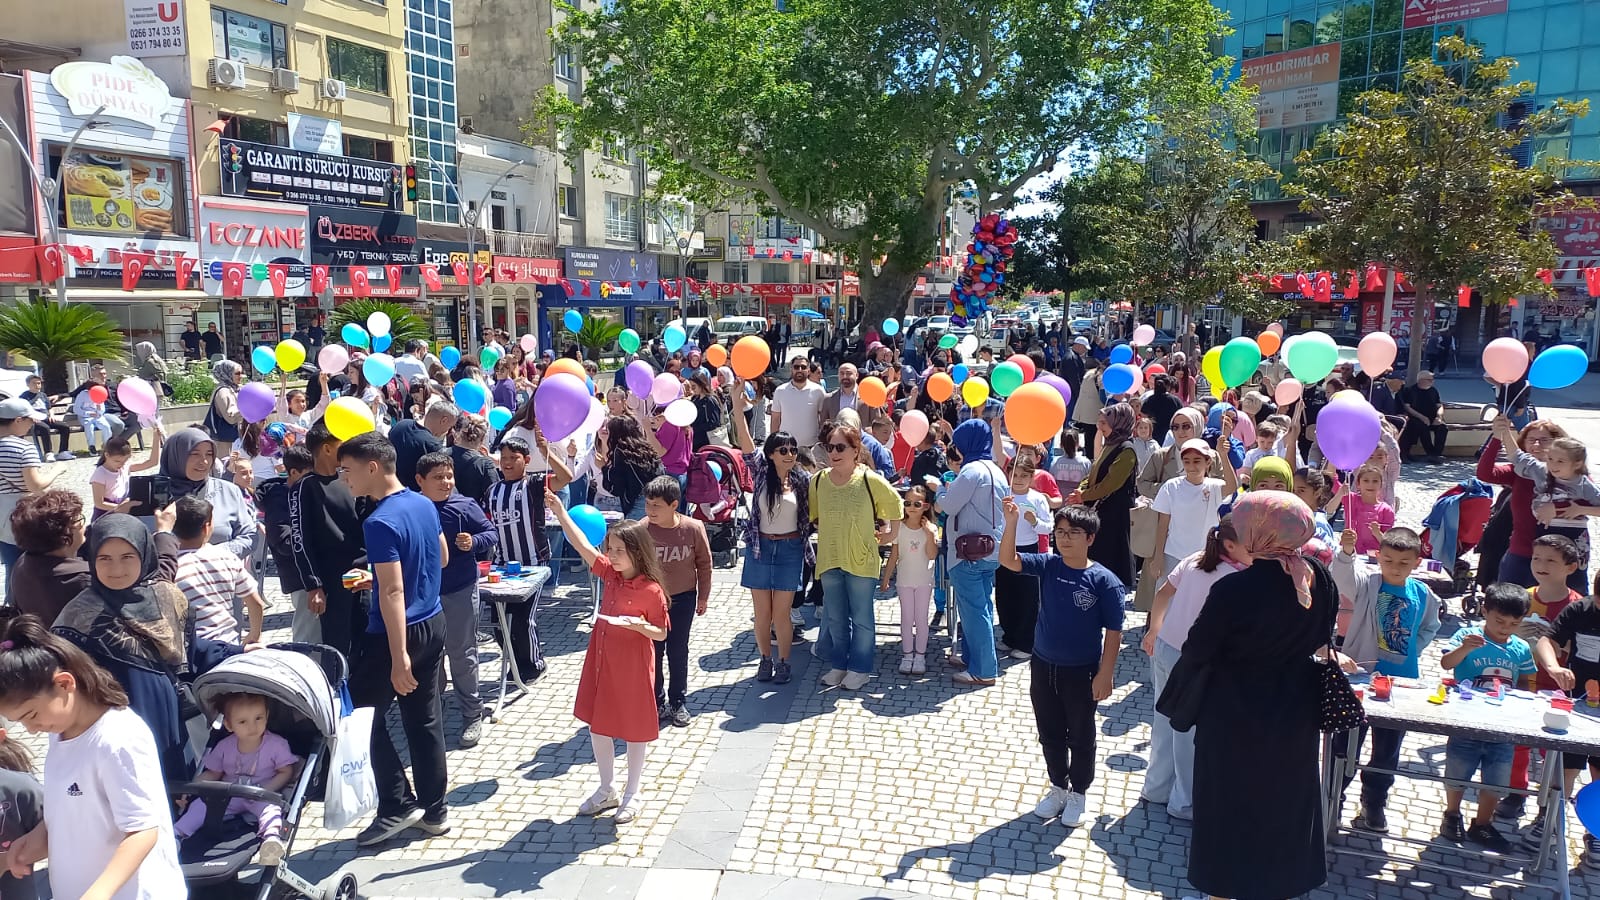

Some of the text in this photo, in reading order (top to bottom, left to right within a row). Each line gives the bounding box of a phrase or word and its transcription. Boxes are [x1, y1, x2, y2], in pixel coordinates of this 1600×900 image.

[130, 26, 180, 38] 0266 374 33 35
[131, 40, 146, 50] 0531
[149, 39, 161, 49] 794
[173, 37, 182, 47] 43
[1247, 53, 1329, 78] ÖZYILDIRIMLAR
[91, 71, 136, 93] PİDE
[78, 90, 155, 119] DÜNYASI
[246, 149, 388, 183] GARANTİ SÜRÜCÜ KURSU
[209, 222, 305, 250] ECZANE
[424, 247, 450, 270] Ege
[290, 491, 304, 552] Calvin Klein
[1473, 657, 1492, 667] MTL
